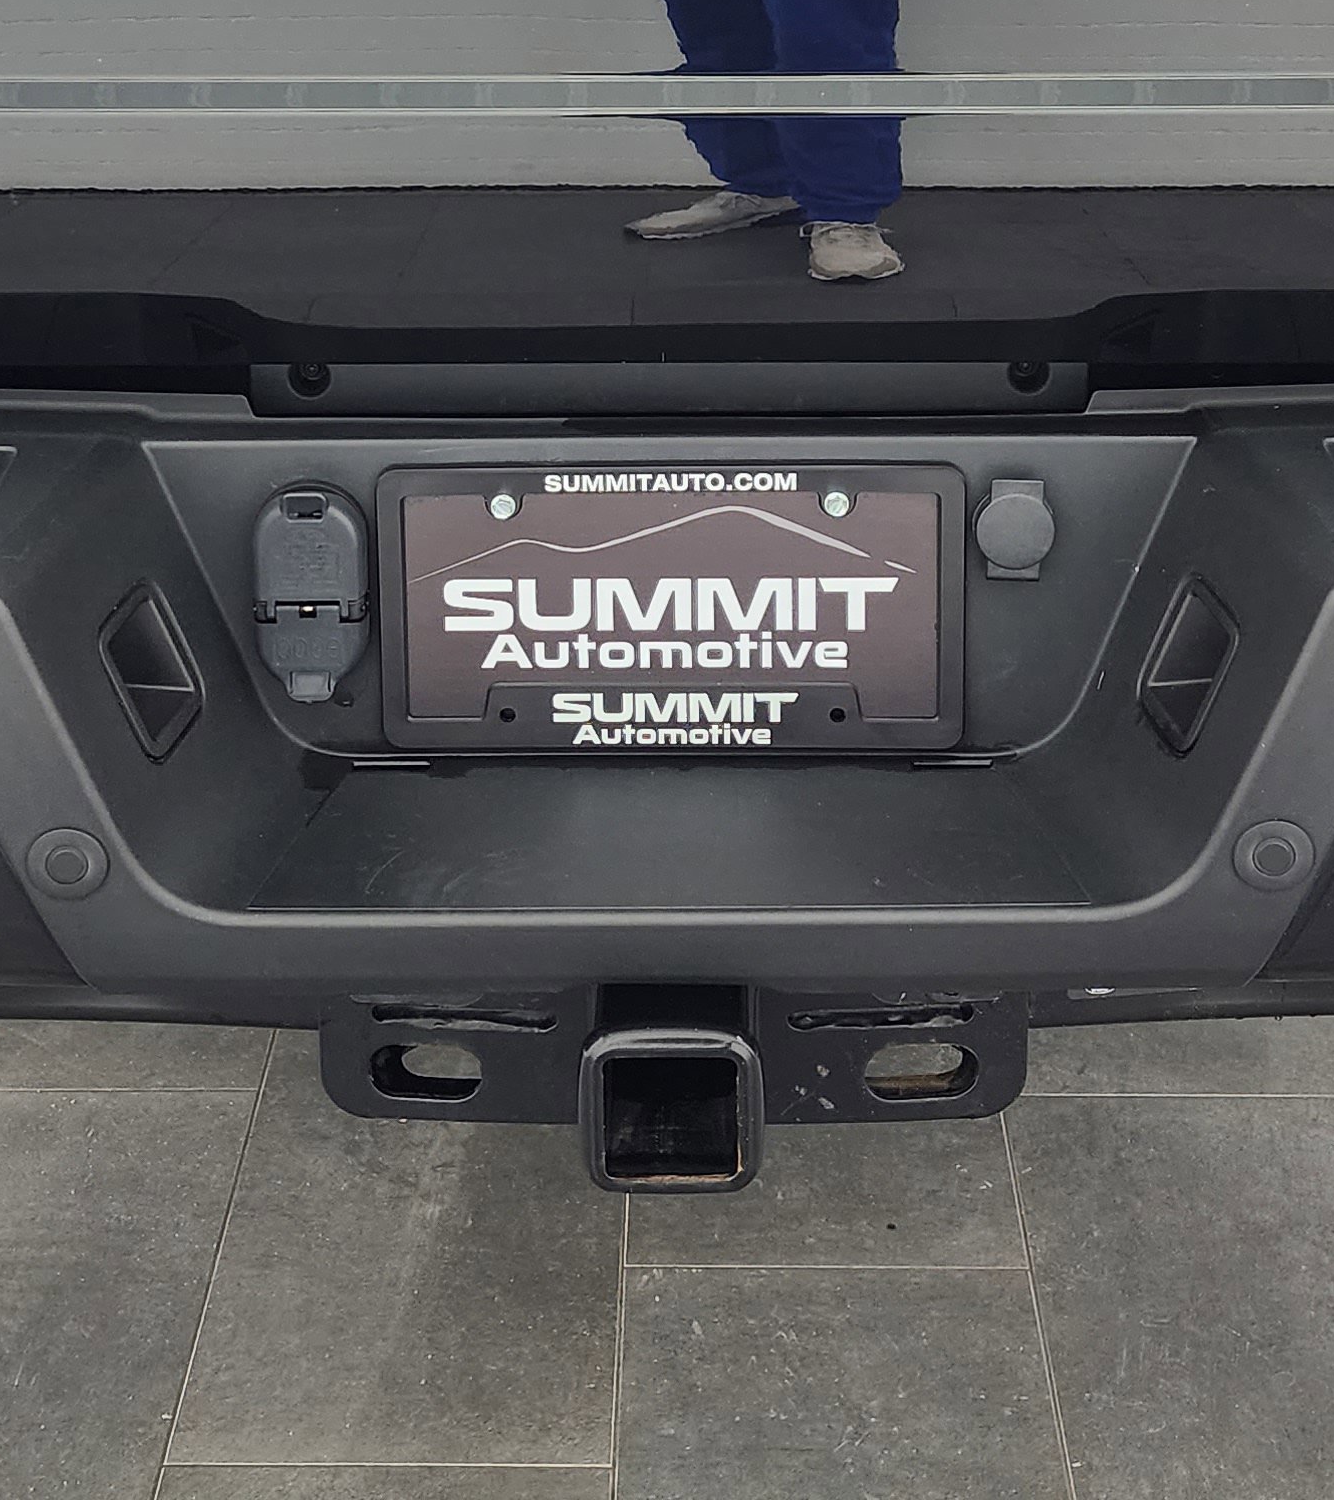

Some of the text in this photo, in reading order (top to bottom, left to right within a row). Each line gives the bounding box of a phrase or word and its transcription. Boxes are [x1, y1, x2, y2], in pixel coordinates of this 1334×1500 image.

[543, 472, 799, 493] SUMMITAUTO.COM
[442, 576, 900, 632] SUMMIT
[480, 631, 849, 669] Automotive
[551, 692, 800, 723] SUMMIT
[572, 723, 773, 745] Automotive
